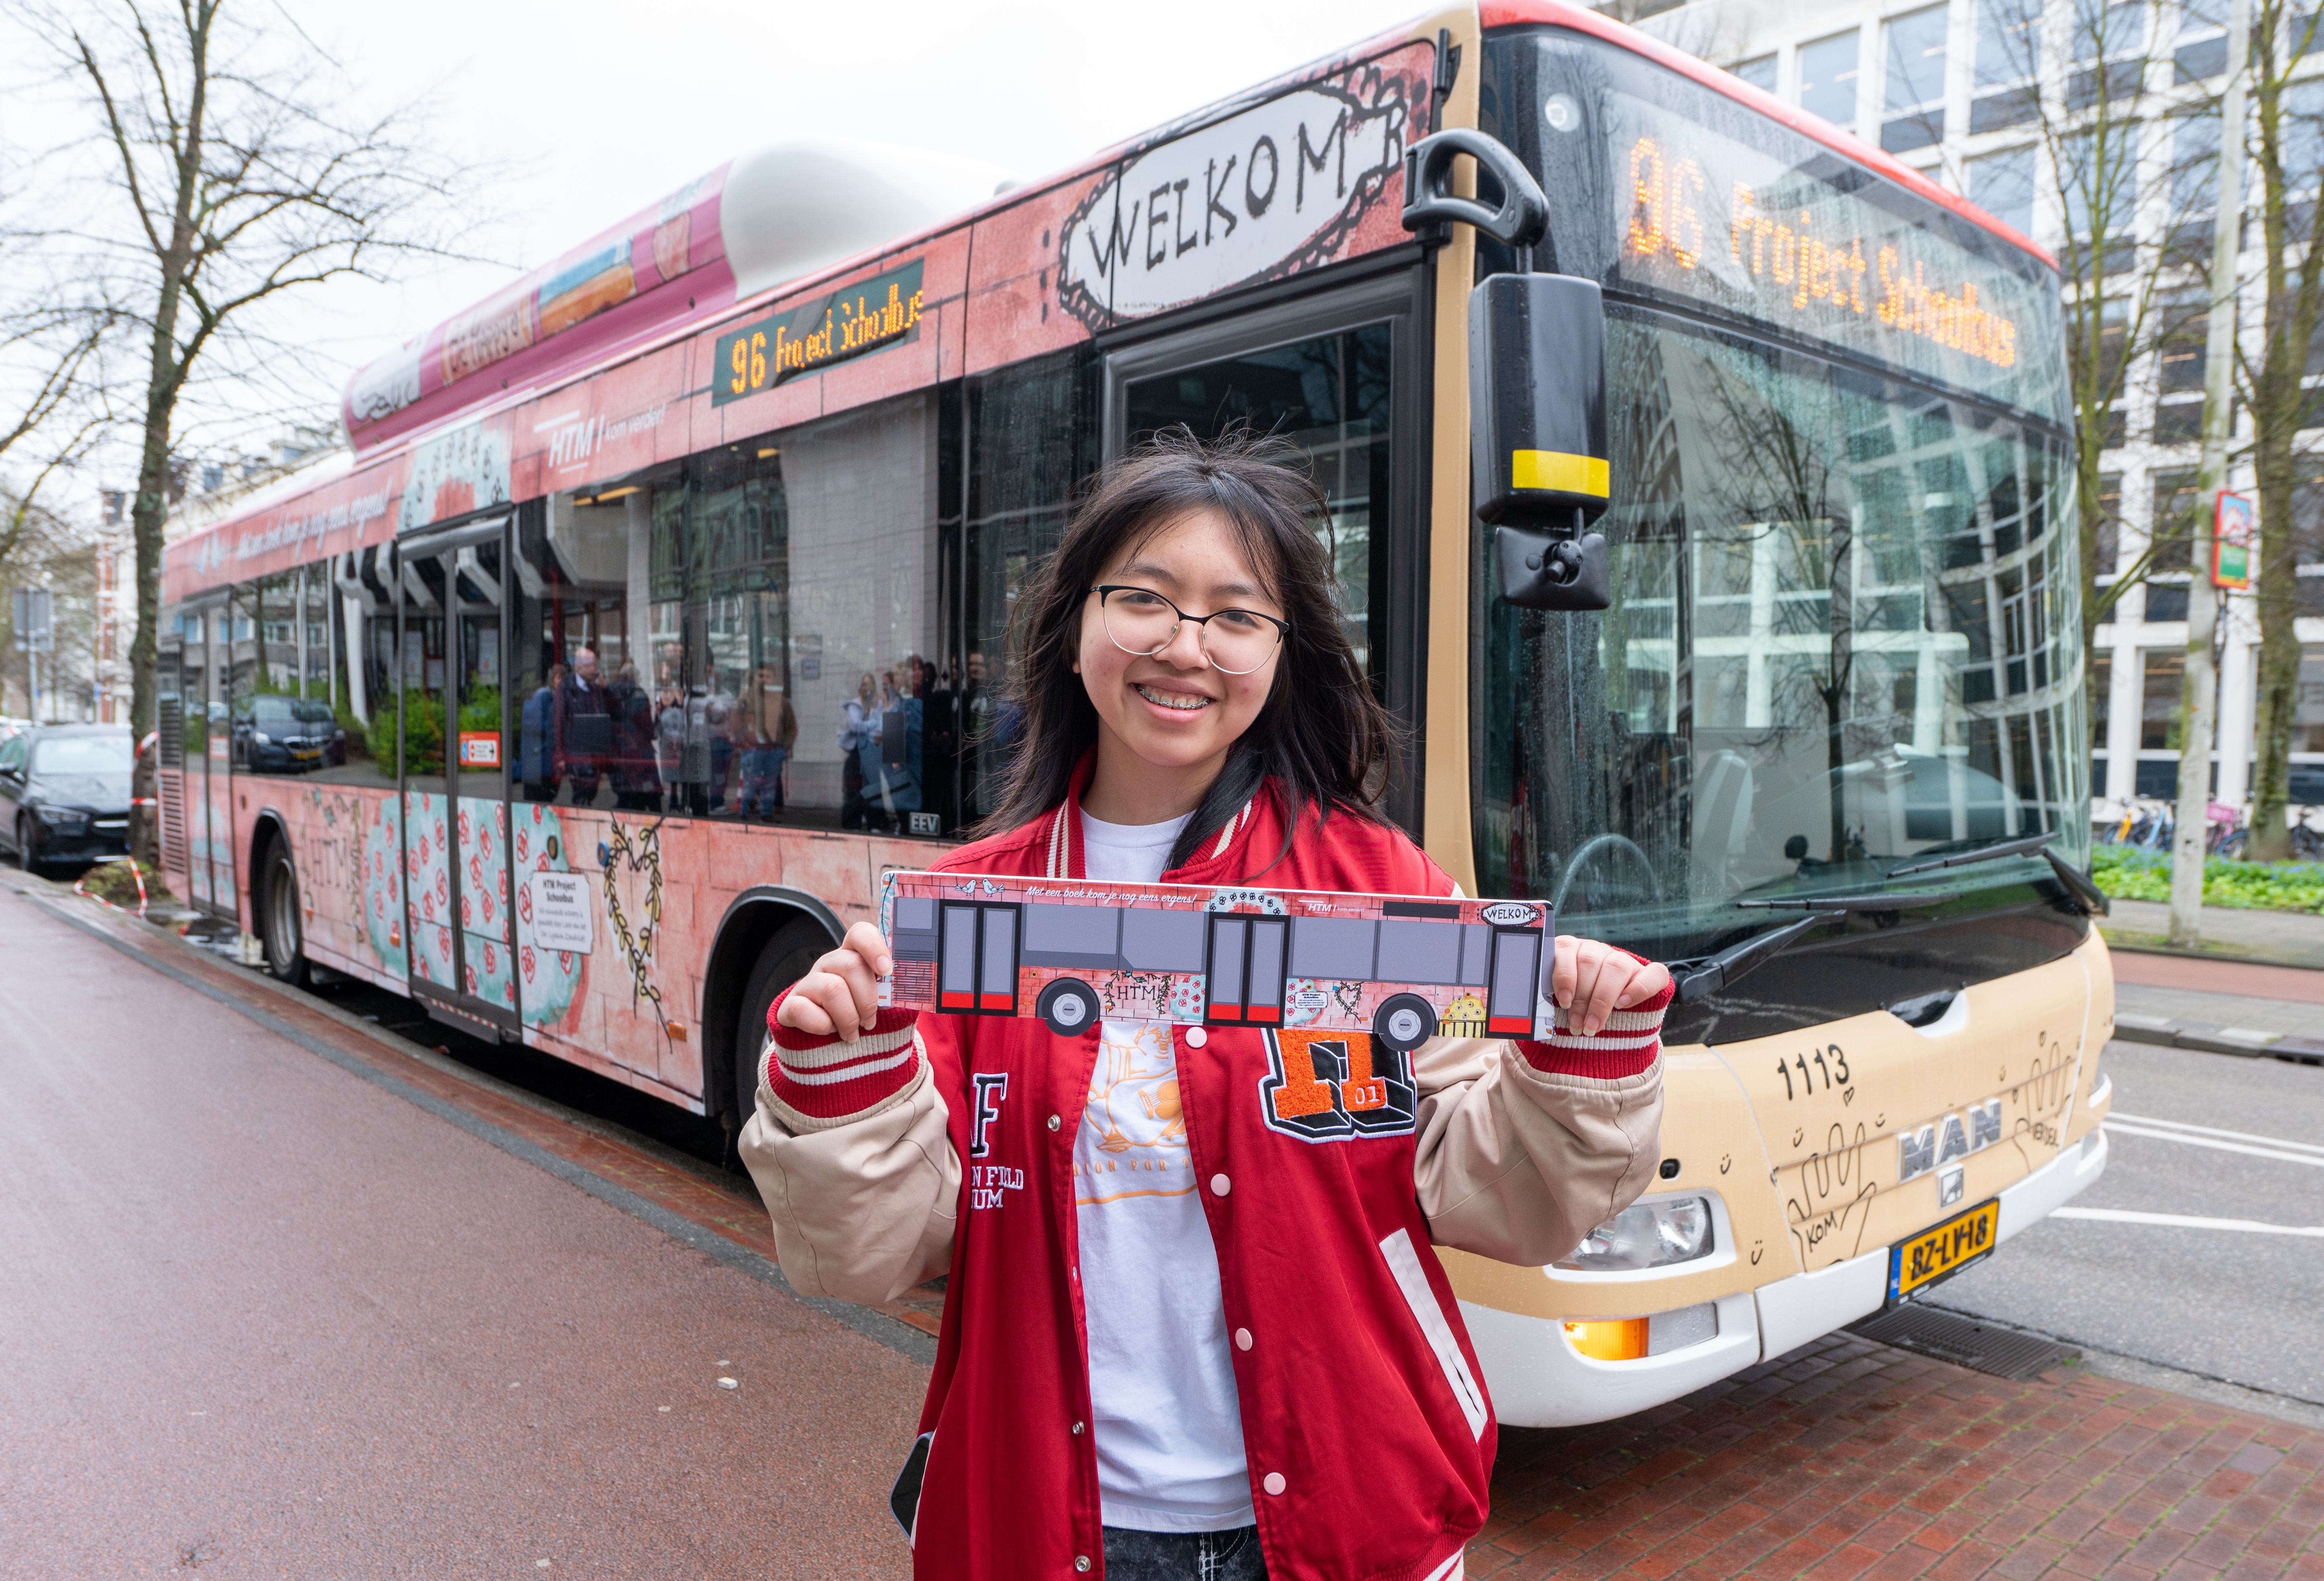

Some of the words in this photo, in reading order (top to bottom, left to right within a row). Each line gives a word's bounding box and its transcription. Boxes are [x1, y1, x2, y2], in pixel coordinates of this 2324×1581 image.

[1086, 108, 1346, 277] WELKOM
[1630, 138, 1703, 269] 96
[1732, 180, 1866, 313] Project
[732, 332, 766, 393] 96
[549, 417, 595, 468] HTM
[911, 815, 938, 832] EEV
[1025, 885, 1044, 896] Met
[1045, 889, 1062, 897] een
[1063, 887, 1085, 898] boek
[1086, 888, 1107, 899] kom
[1105, 891, 1117, 904] je
[1119, 893, 1136, 905] nog
[1139, 894, 1159, 902] eens
[1161, 894, 1197, 907] ergens!
[1308, 903, 1332, 912] HTM
[1487, 909, 1531, 919] WELKOM
[1117, 985, 1156, 1000] HTM
[1777, 1044, 1849, 1100] 1113
[1355, 1086, 1381, 1105] 01
[1897, 1098, 2002, 1185] MAN
[1131, 1159, 1166, 1171] FOR
[1806, 1211, 1837, 1253] KOM
